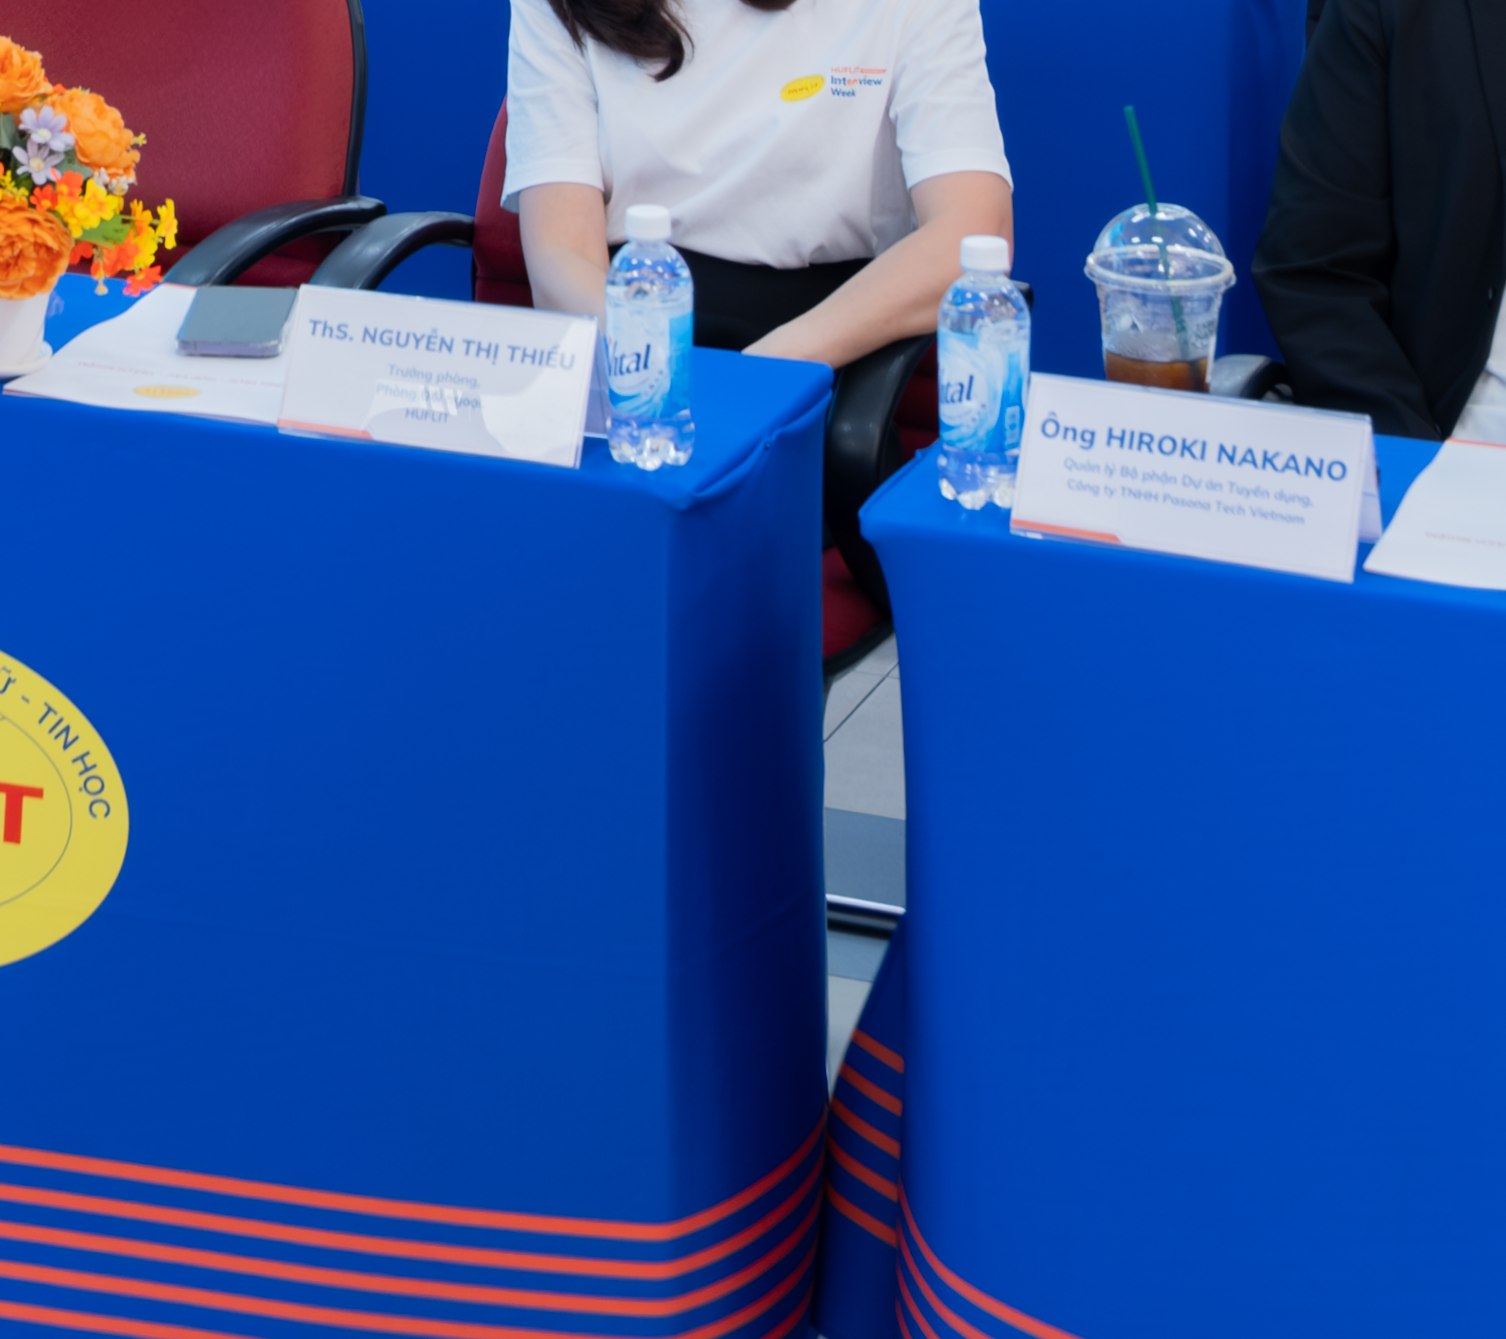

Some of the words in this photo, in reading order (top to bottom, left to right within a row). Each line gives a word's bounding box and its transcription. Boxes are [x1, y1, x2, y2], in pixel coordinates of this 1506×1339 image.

[831, 75, 883, 87] Interview
[831, 87, 857, 98] Week
[308, 318, 354, 342] ThS.
[361, 325, 454, 356] NGUYỄN
[462, 339, 500, 365] THỊ
[506, 344, 576, 371] THIẾU
[1041, 411, 1096, 450] Ông
[1106, 426, 1207, 461] HIROKI
[1217, 442, 1347, 482] NAKANO
[1162, 493, 1211, 511] Pasona
[1249, 506, 1305, 525] Vietnam
[36, 702, 80, 752] TIN
[70, 750, 112, 821] HỌC
